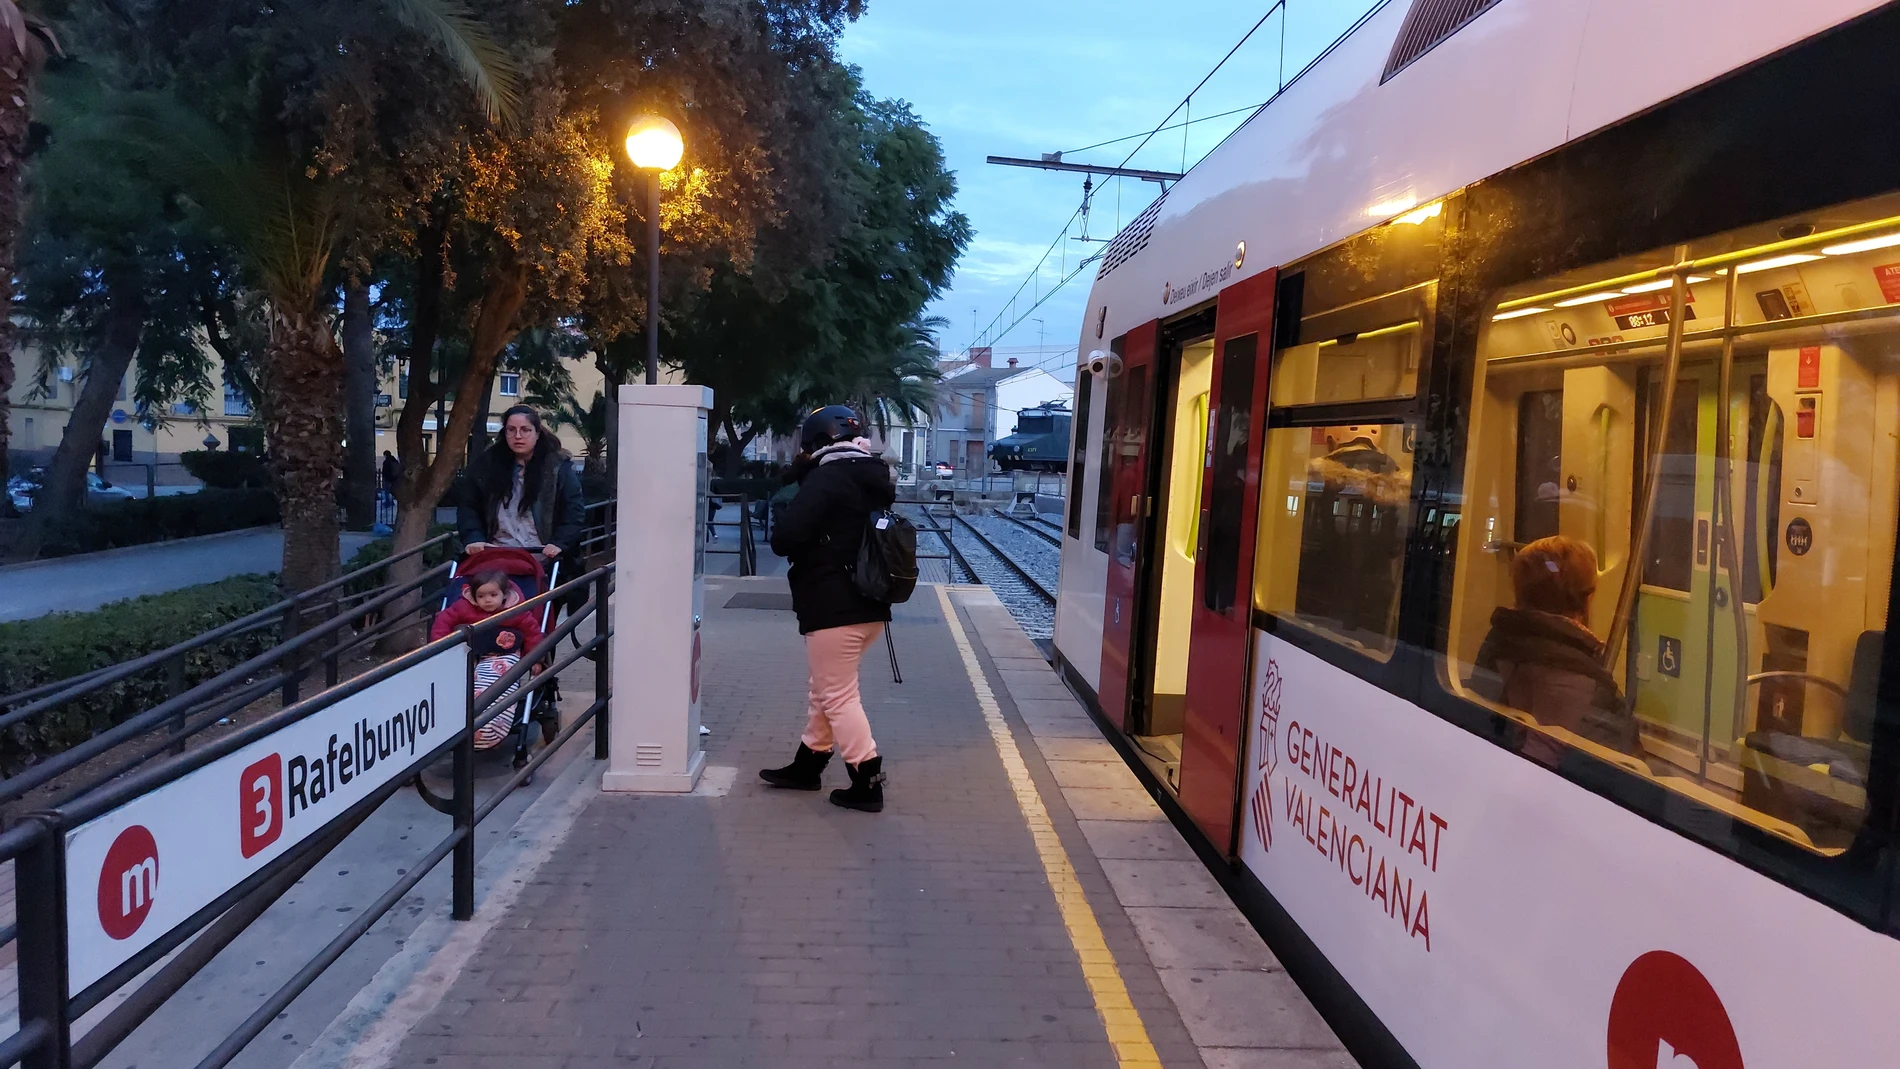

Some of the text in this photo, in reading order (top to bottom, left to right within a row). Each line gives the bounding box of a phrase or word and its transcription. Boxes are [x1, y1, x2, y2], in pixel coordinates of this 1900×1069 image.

[1202, 269, 1219, 292] Dejen
[252, 683, 437, 838] 3 Rafelbunyol
[1287, 720, 1447, 872] GENERALITAT
[121, 856, 157, 917] m
[1285, 777, 1430, 952] VALENCIANA
